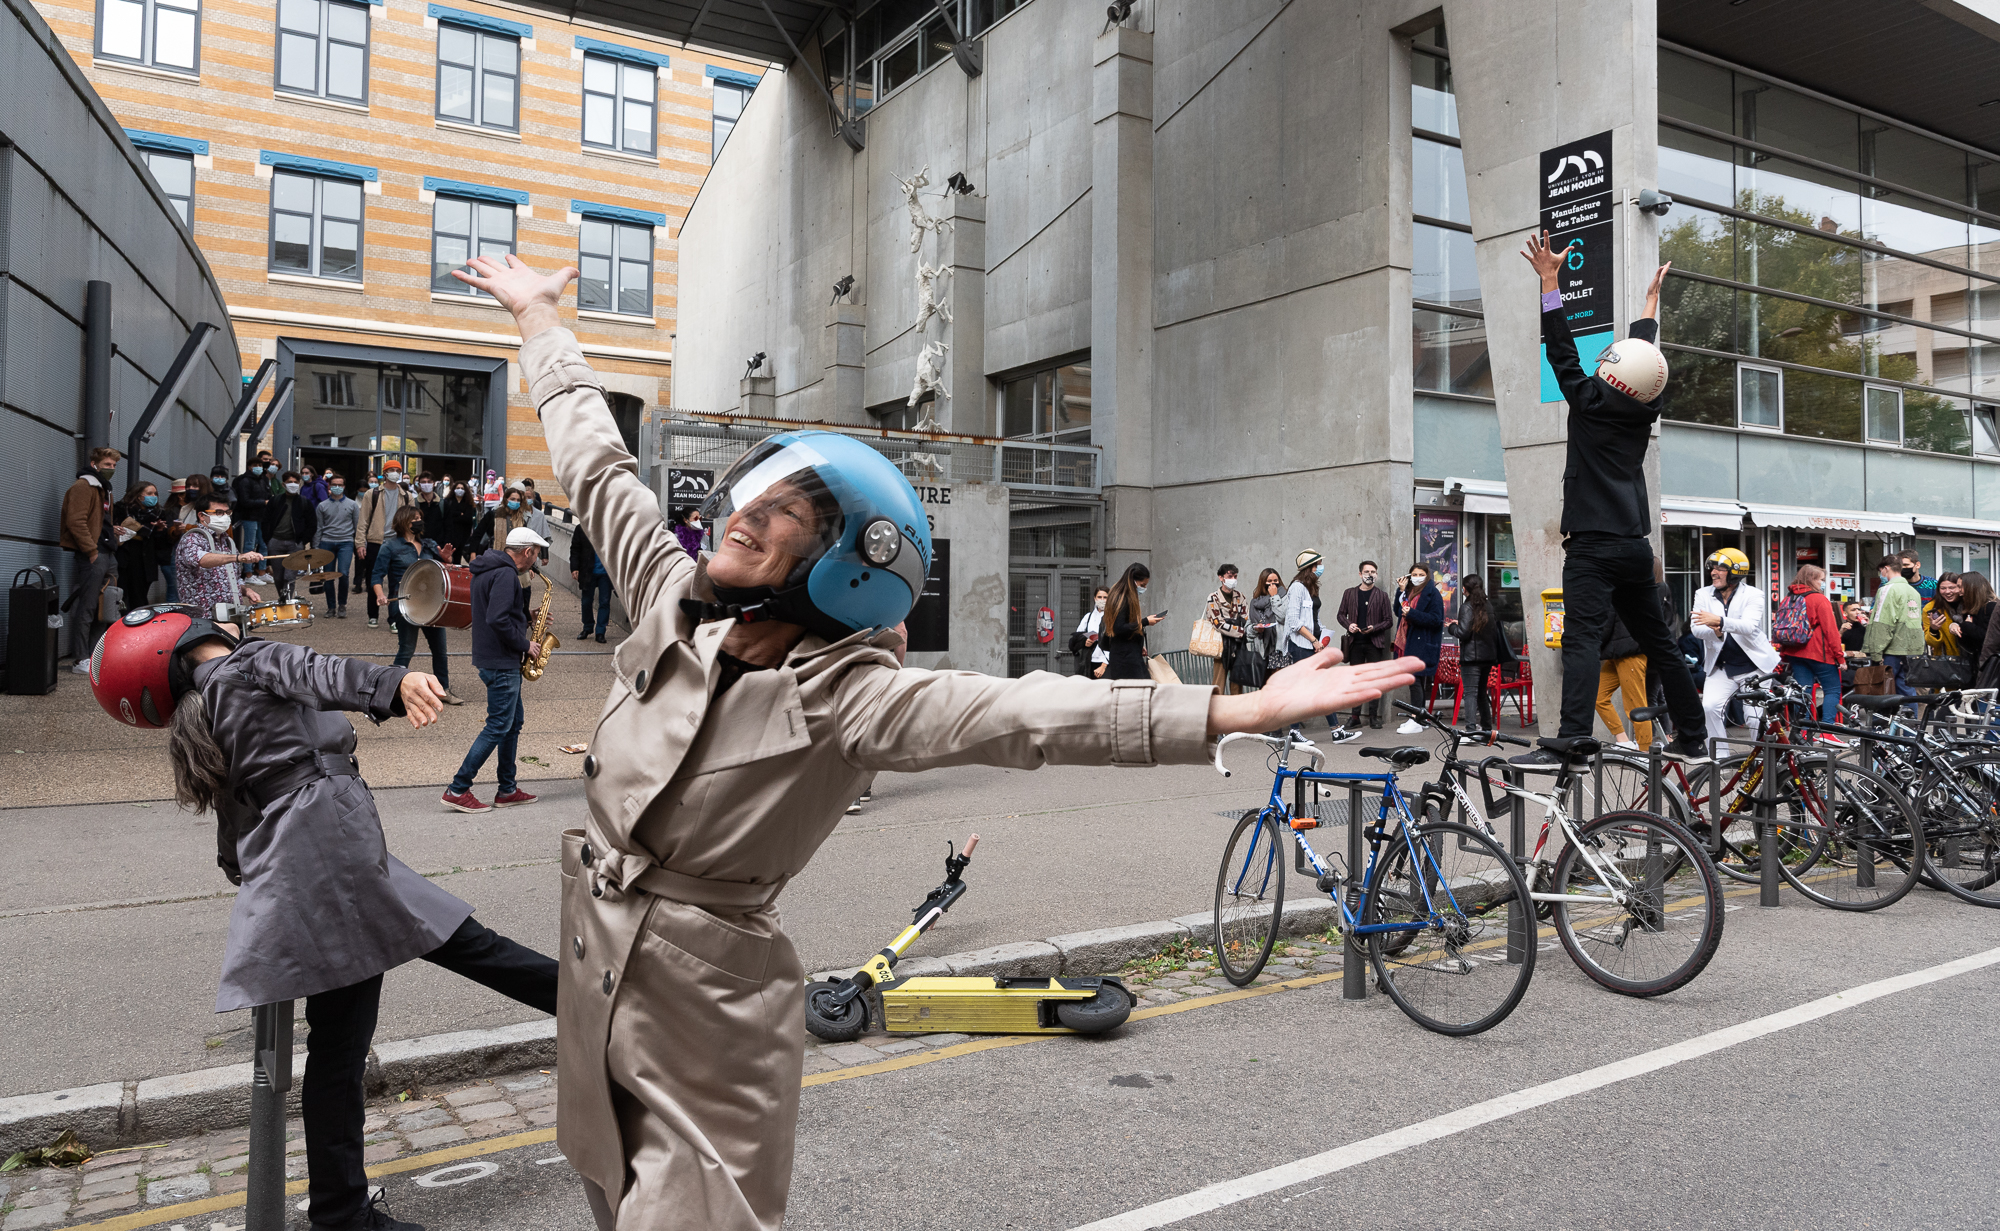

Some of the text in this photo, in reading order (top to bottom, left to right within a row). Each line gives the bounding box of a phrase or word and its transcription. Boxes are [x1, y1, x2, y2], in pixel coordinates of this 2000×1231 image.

[1548, 175, 1604, 198] JEAN MOULIN
[1551, 201, 1601, 219] Manufacture
[1556, 212, 1598, 228] des Tabacs
[1568, 238, 1584, 270] 6
[1560, 287, 1594, 301] ROLLET
[1574, 310, 1594, 319] NORD
[1835, 518, 1861, 529] CREUSE
[1771, 542, 1780, 601] CREUSE
[1451, 782, 1485, 831] DECATHLON
